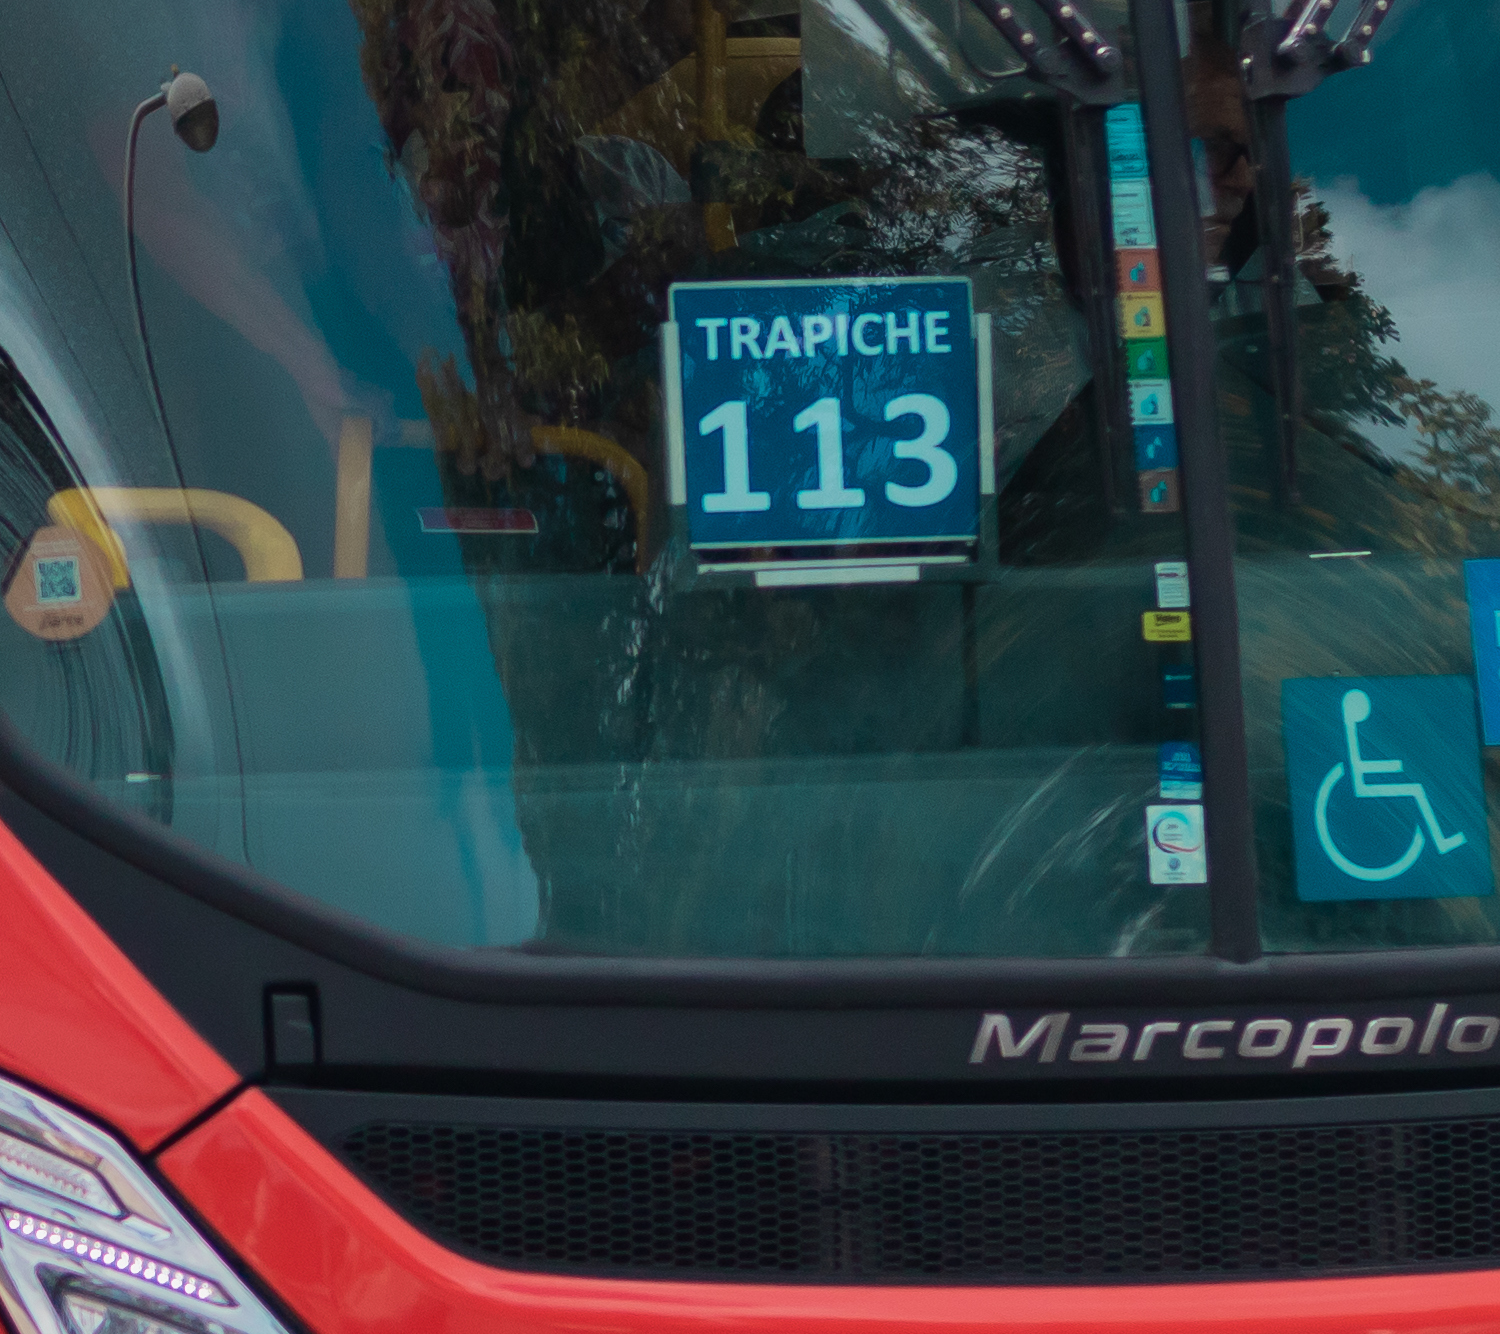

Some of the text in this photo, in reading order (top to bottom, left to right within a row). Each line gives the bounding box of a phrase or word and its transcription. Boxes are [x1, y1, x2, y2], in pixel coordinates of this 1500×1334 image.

[695, 311, 953, 361] TRAPICHE
[699, 393, 958, 513] 113
[968, 1003, 1500, 1069] Marcopolo
